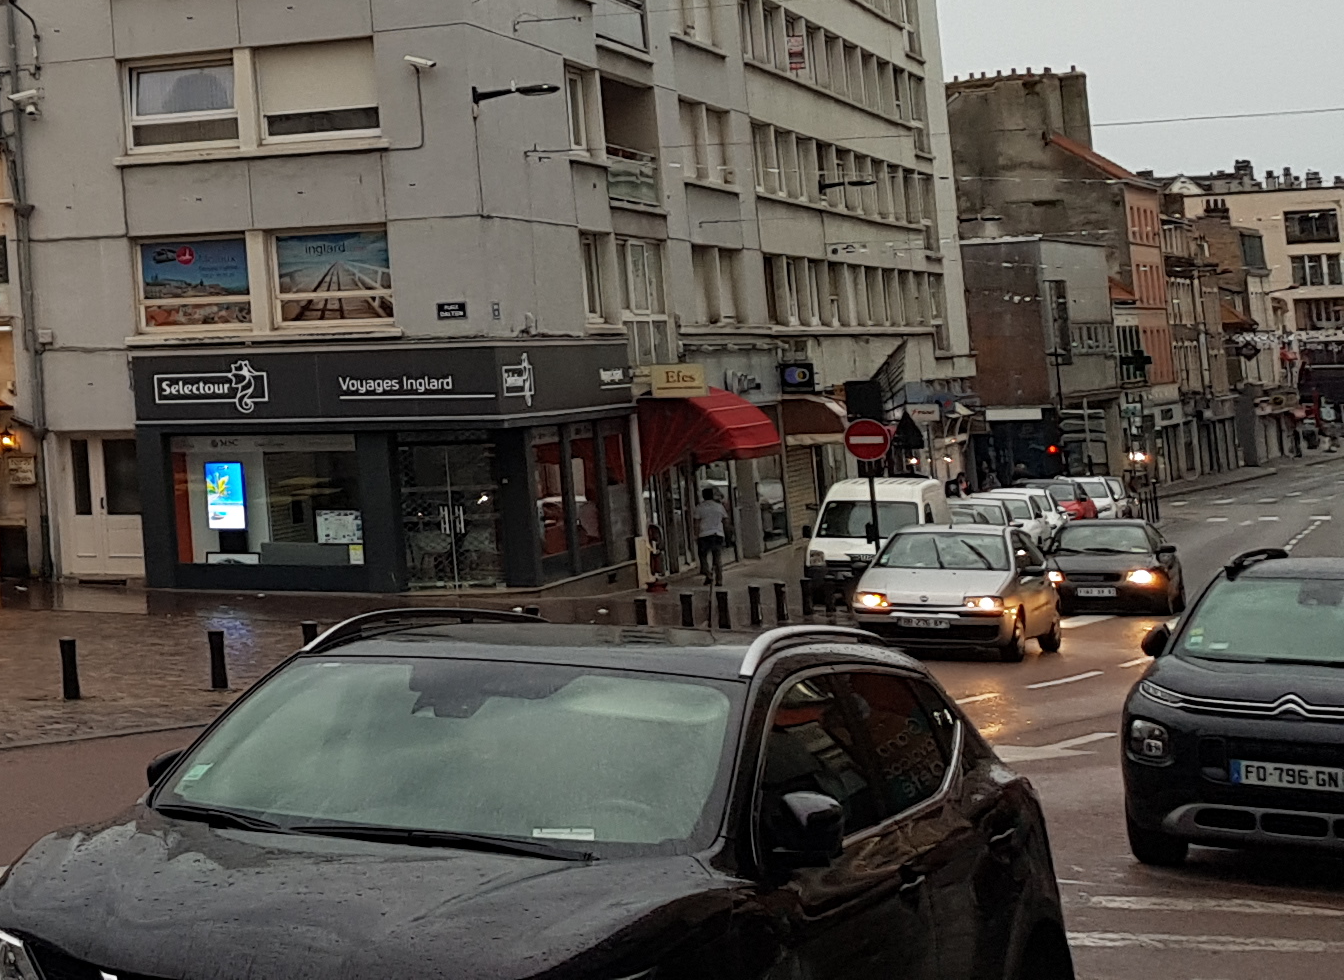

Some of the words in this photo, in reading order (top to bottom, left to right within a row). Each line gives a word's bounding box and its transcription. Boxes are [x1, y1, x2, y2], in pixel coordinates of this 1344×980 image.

[305, 241, 346, 256] inglard
[162, 380, 230, 395] Selectour
[338, 375, 400, 393] Voyages
[403, 375, 453, 393] Inglard
